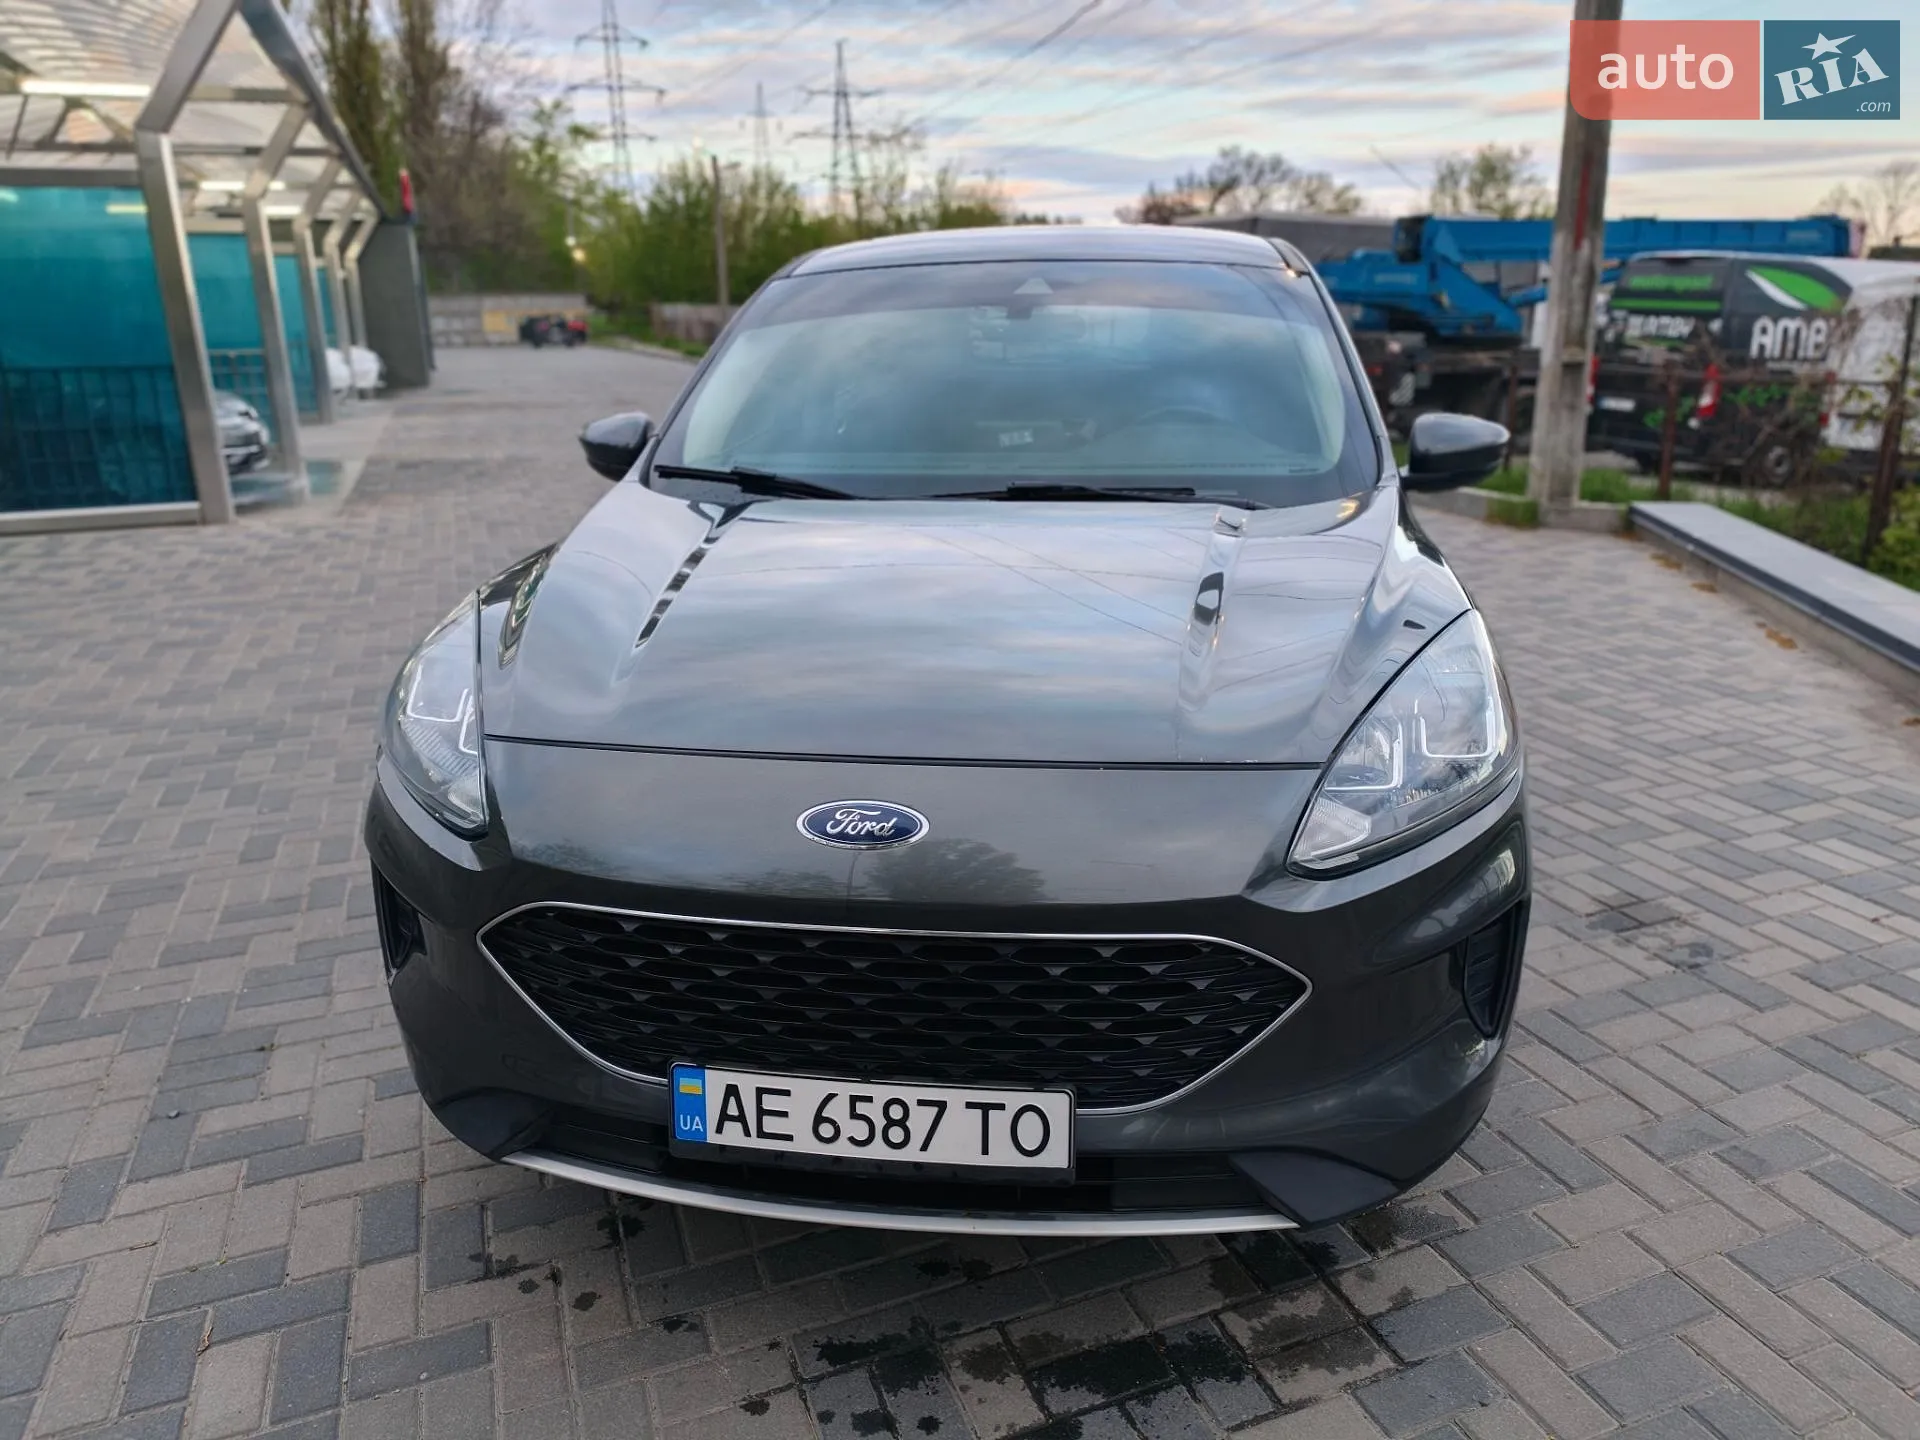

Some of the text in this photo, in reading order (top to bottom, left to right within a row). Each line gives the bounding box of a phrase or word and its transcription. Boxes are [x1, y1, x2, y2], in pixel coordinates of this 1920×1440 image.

[826, 808, 898, 836] Ford
[679, 1114, 704, 1133] UA
[715, 1083, 1051, 1158] AE 6587 TO
